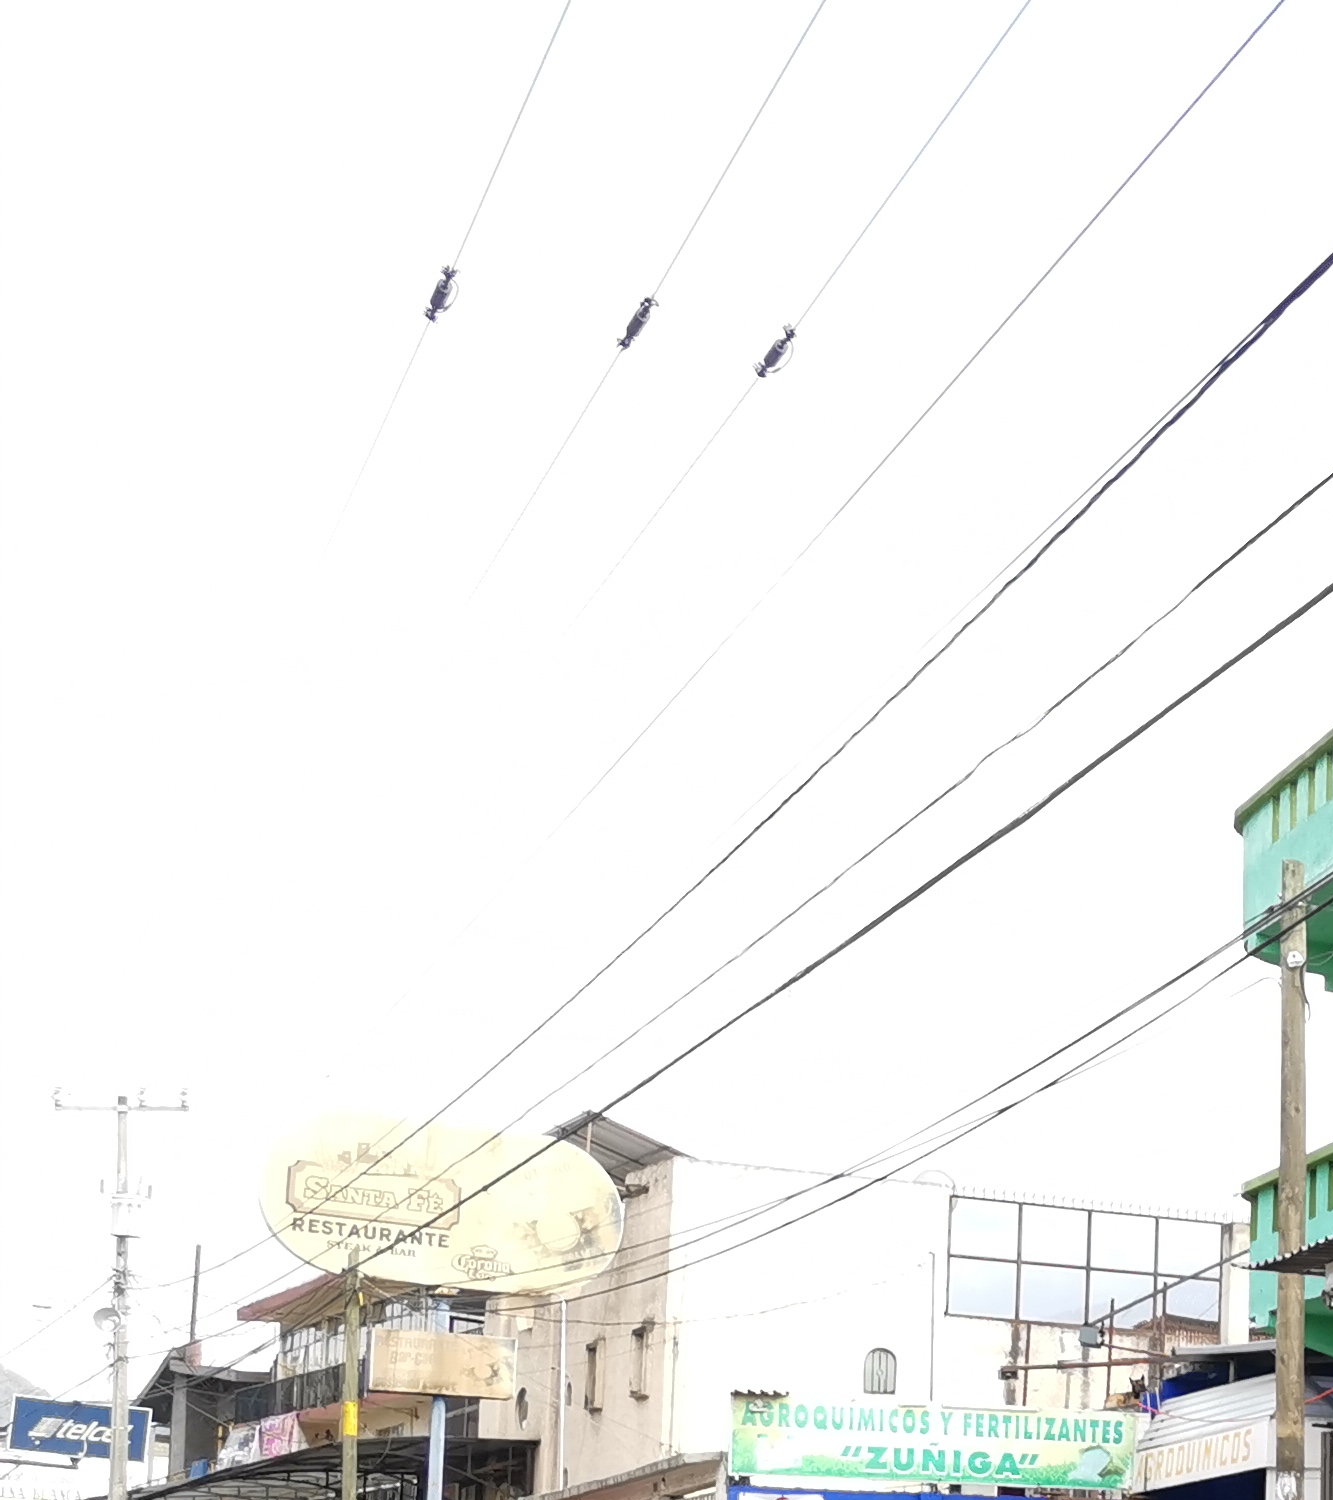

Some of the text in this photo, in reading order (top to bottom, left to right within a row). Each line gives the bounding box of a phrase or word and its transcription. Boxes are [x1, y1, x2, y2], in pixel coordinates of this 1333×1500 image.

[303, 1175, 399, 1210] SANTA
[291, 1217, 450, 1249] RESTAURANTE
[56, 1418, 133, 1446] telce
[940, 1411, 953, 1436] Y
[963, 1412, 1124, 1445] FERTILIZANTES
